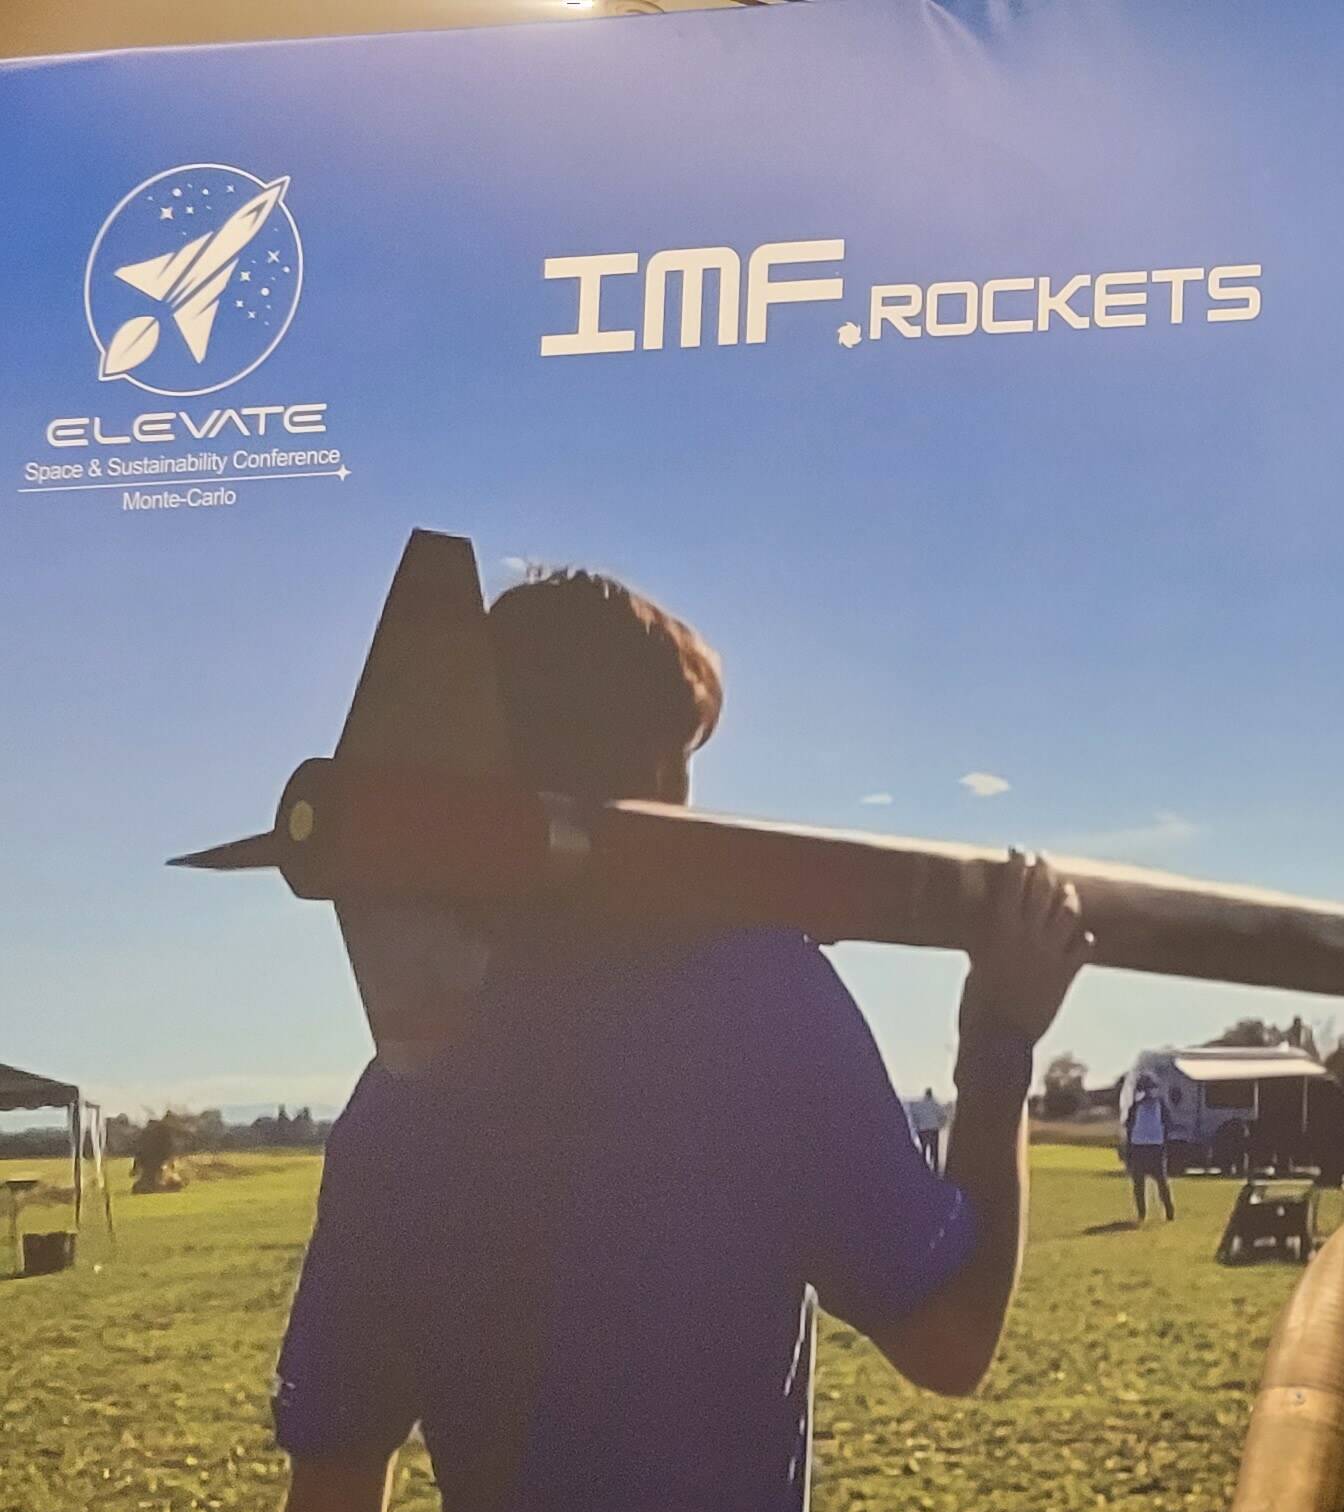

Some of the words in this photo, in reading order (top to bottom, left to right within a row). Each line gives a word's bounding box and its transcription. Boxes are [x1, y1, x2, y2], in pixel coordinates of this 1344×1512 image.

[46, 403, 328, 447] ELEVATE
[24, 461, 84, 484] Space
[88, 459, 103, 478] &
[107, 452, 228, 477] Sustainability
[233, 448, 340, 470] Conference
[122, 487, 237, 511] Monte-Carlo
